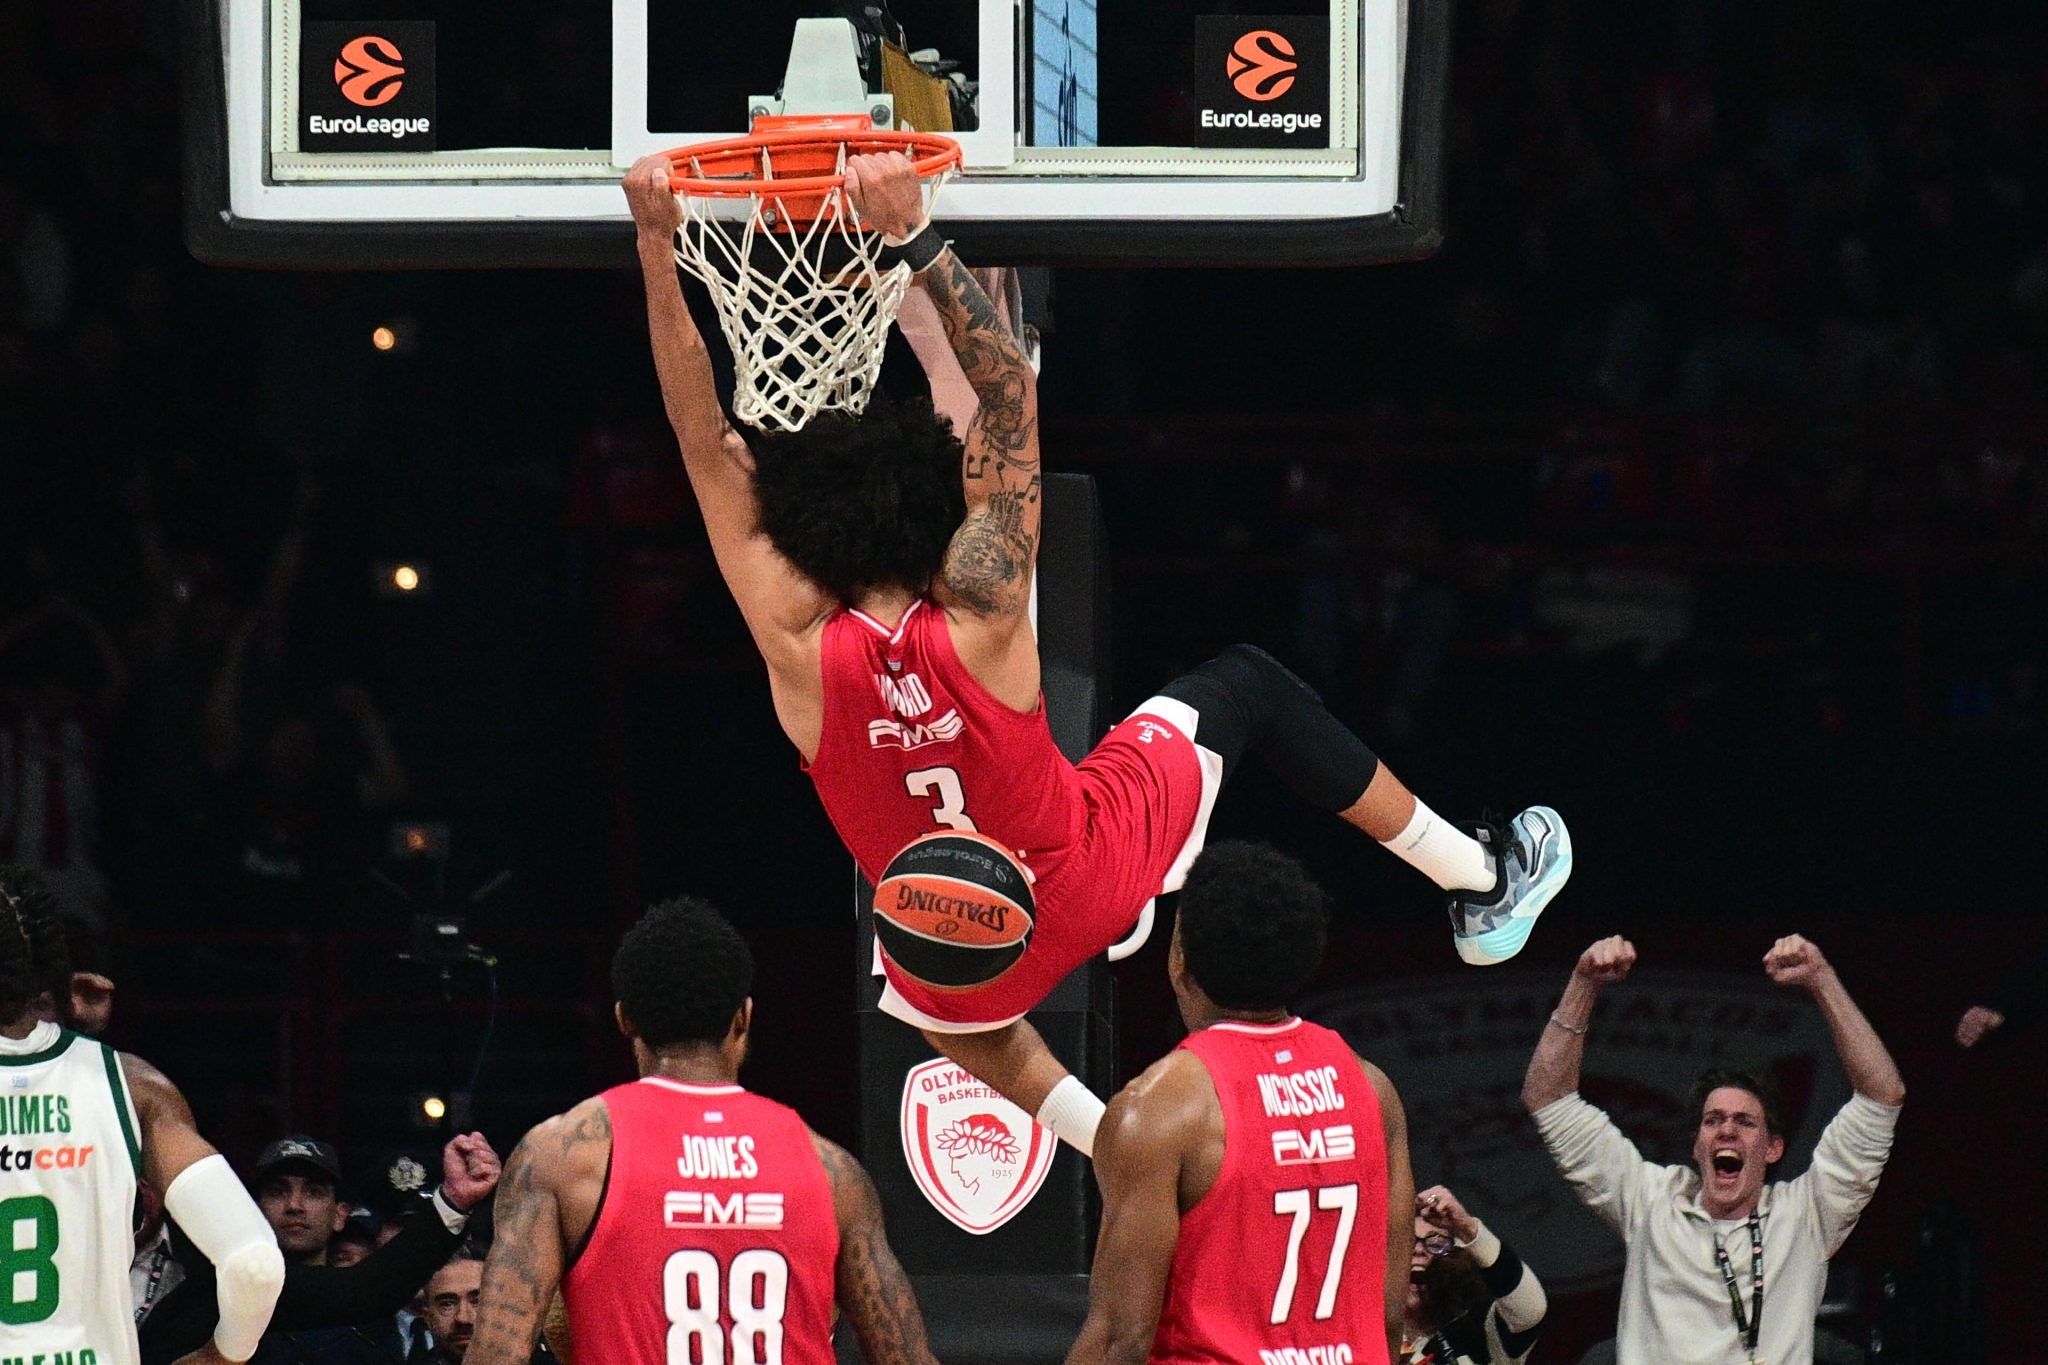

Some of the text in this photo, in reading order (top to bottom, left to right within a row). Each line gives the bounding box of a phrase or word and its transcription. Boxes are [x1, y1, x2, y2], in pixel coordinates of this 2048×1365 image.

[309, 114, 430, 138] EuroLeague
[1201, 109, 1322, 133] EuroLeague
[868, 708, 964, 750] FMS
[904, 766, 979, 836] 3
[897, 883, 1009, 932] SPALDING
[677, 1133, 759, 1180] JONES
[1272, 1124, 1356, 1164] FMS
[991, 1169, 1013, 1179] 1925
[664, 1190, 784, 1228] FMS
[1270, 1183, 1358, 1324] 77
[663, 1249, 789, 1365] 88
